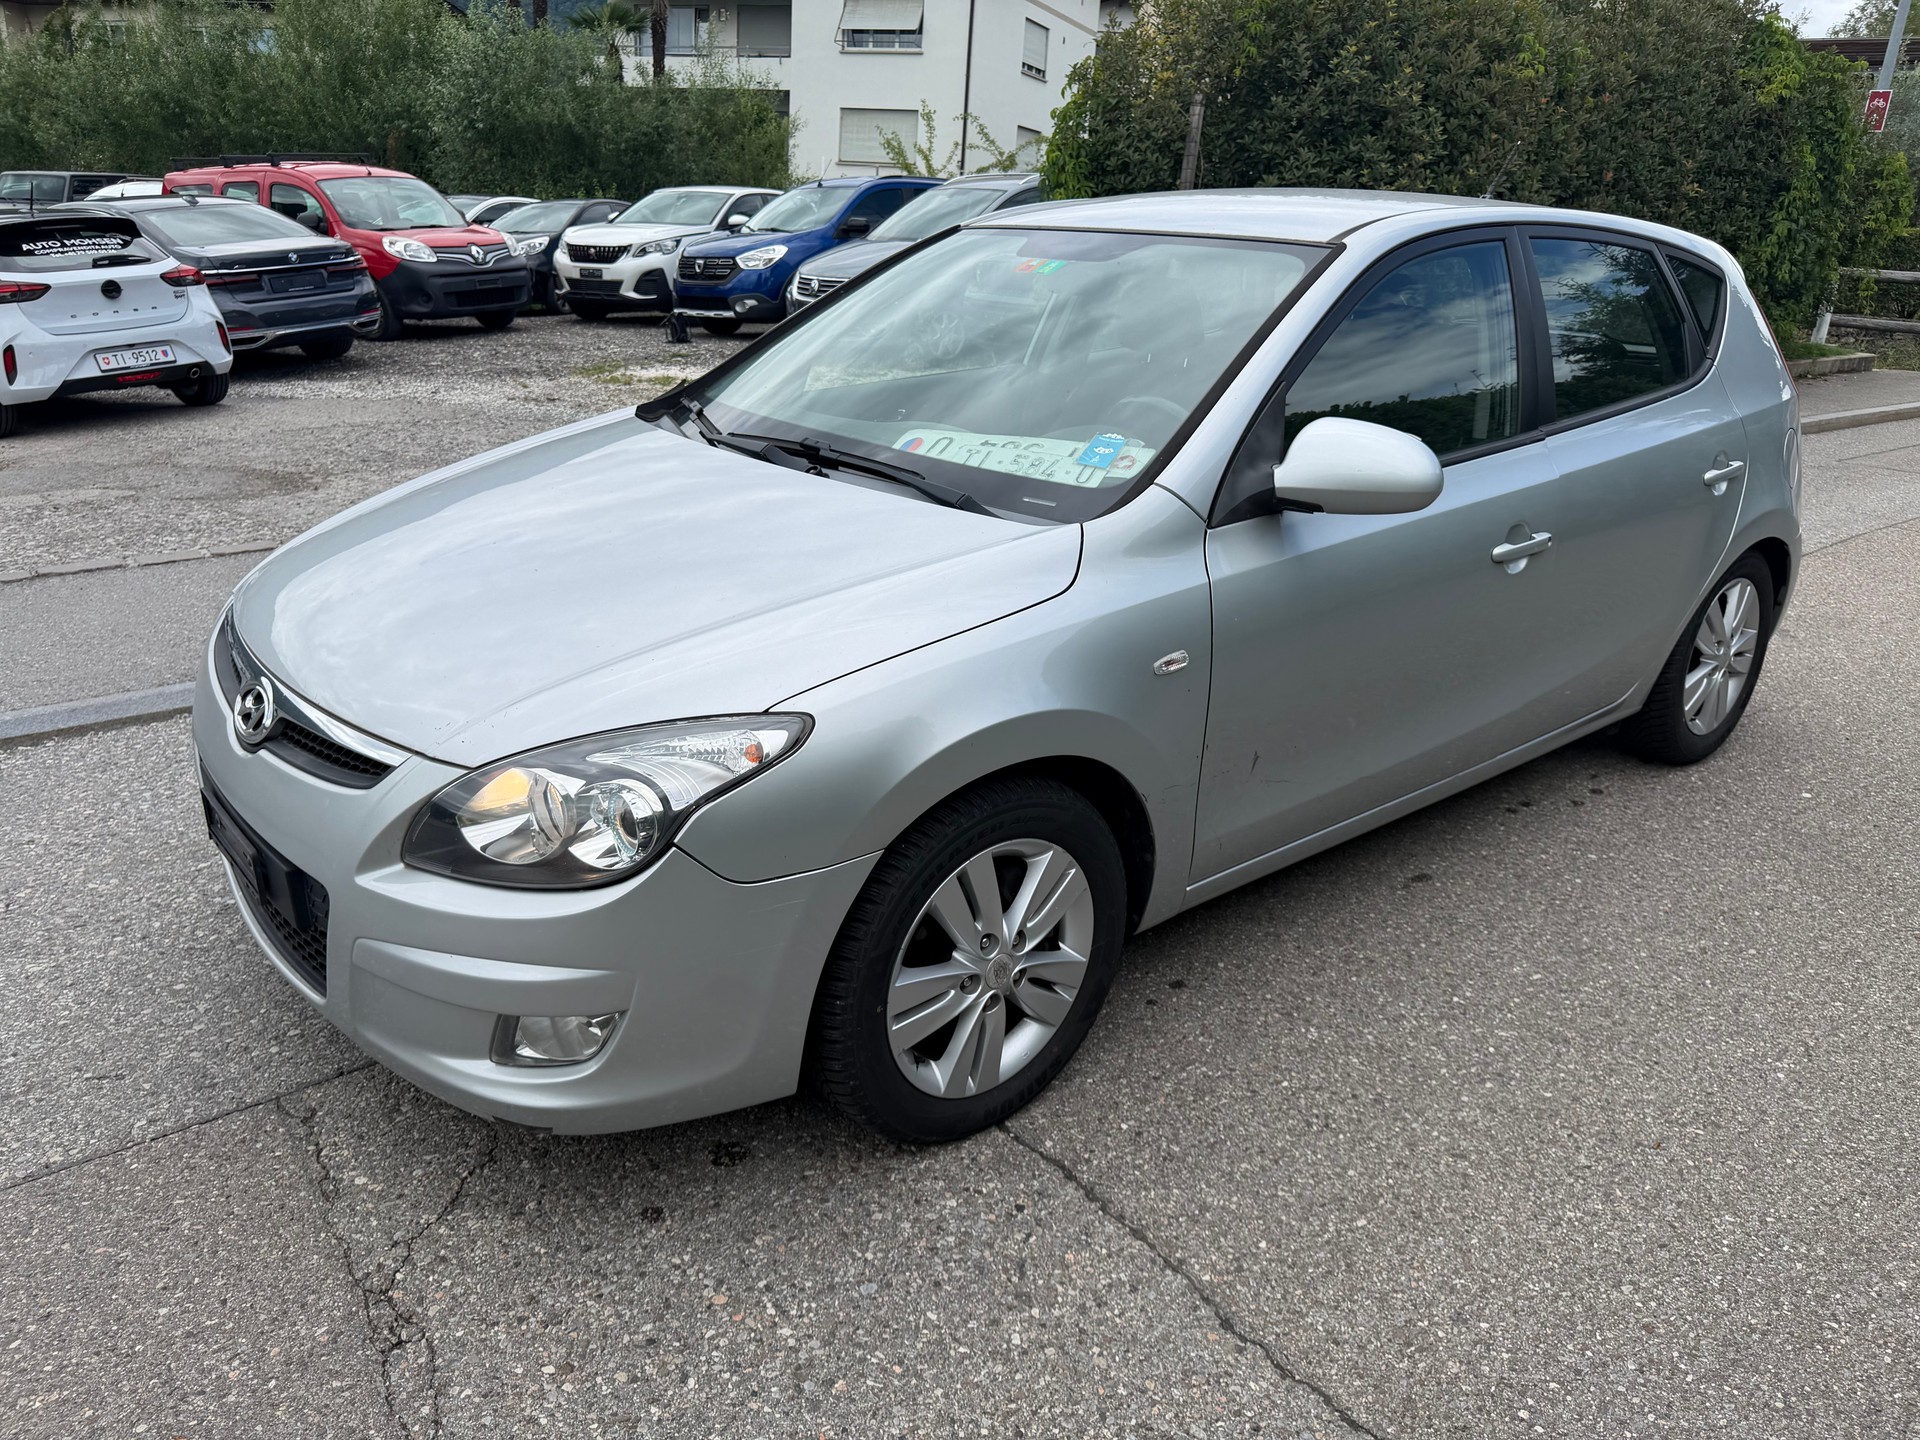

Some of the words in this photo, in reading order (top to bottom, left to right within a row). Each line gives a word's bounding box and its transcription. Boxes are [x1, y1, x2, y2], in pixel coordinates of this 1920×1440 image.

[21, 240, 61, 251] AUTO
[63, 237, 124, 247] MOHSEN
[34, 245, 100, 255] COMPRAVENDITA
